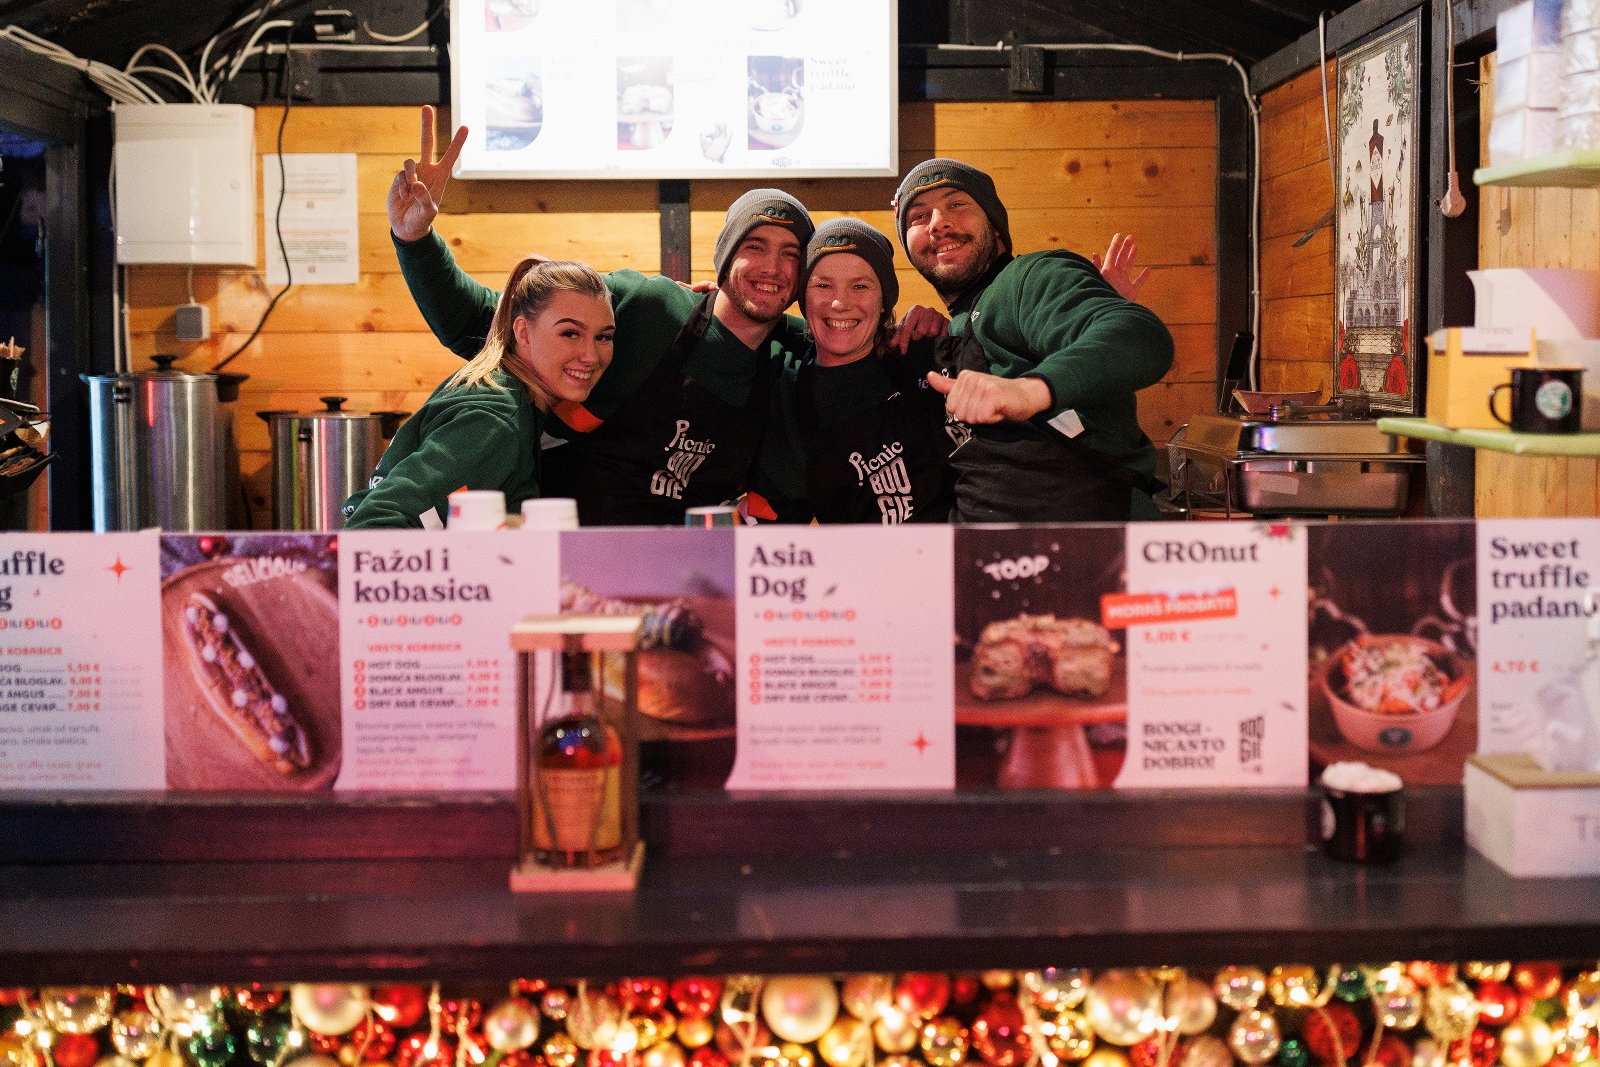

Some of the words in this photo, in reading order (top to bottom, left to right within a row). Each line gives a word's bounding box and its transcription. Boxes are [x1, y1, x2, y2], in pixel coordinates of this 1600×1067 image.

[664, 419, 716, 454] Picnic
[848, 441, 904, 487] Picnic
[869, 456, 912, 495] BOO
[353, 549, 431, 573] Fažol
[442, 548, 449, 573] i
[750, 542, 815, 567] Asia
[1143, 541, 1258, 564] CROnut
[1490, 536, 1579, 560] Sweet
[983, 554, 1049, 581] TOOP
[1492, 564, 1589, 589] truffle
[354, 577, 492, 603] kobasica
[750, 575, 806, 603] Dog
[0, 703, 18, 712] GE
